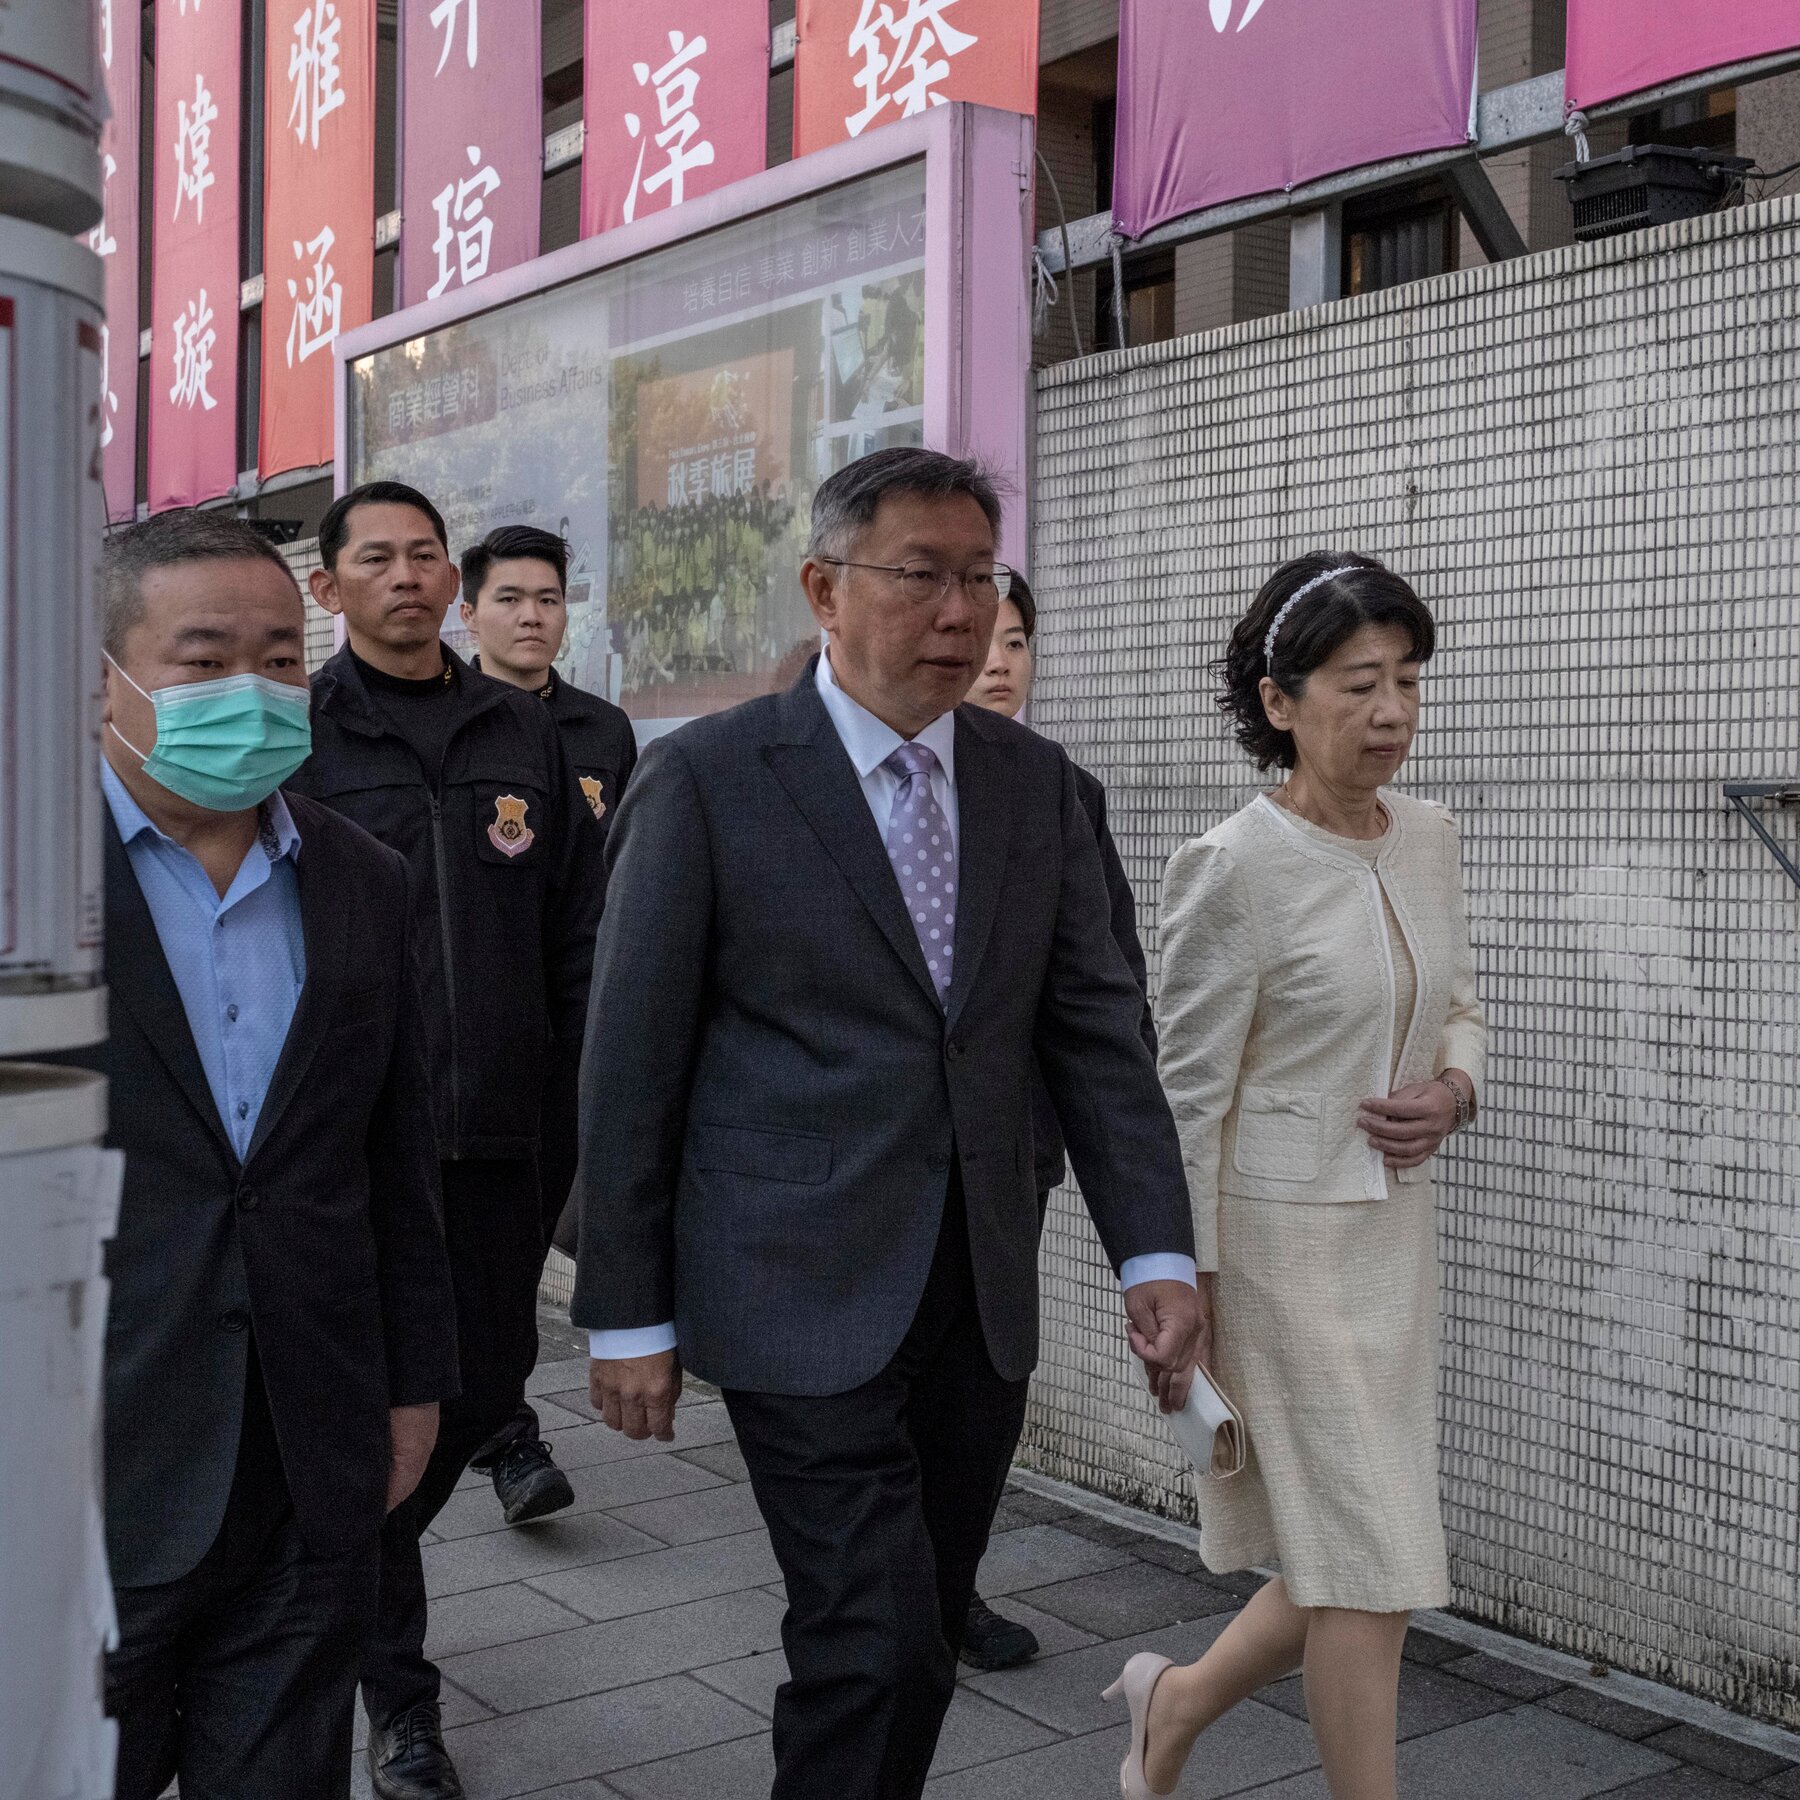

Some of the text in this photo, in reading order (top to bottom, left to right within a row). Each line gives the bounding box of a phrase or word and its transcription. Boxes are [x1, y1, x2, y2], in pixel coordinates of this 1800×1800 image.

[623, 30, 715, 225] 淳
[286, 0, 346, 369] 雅涵
[682, 211, 927, 313] 培養自信 專業 創新 創業人才
[388, 363, 480, 434] 商業經營科
[500, 365, 603, 411] Business Affairs
